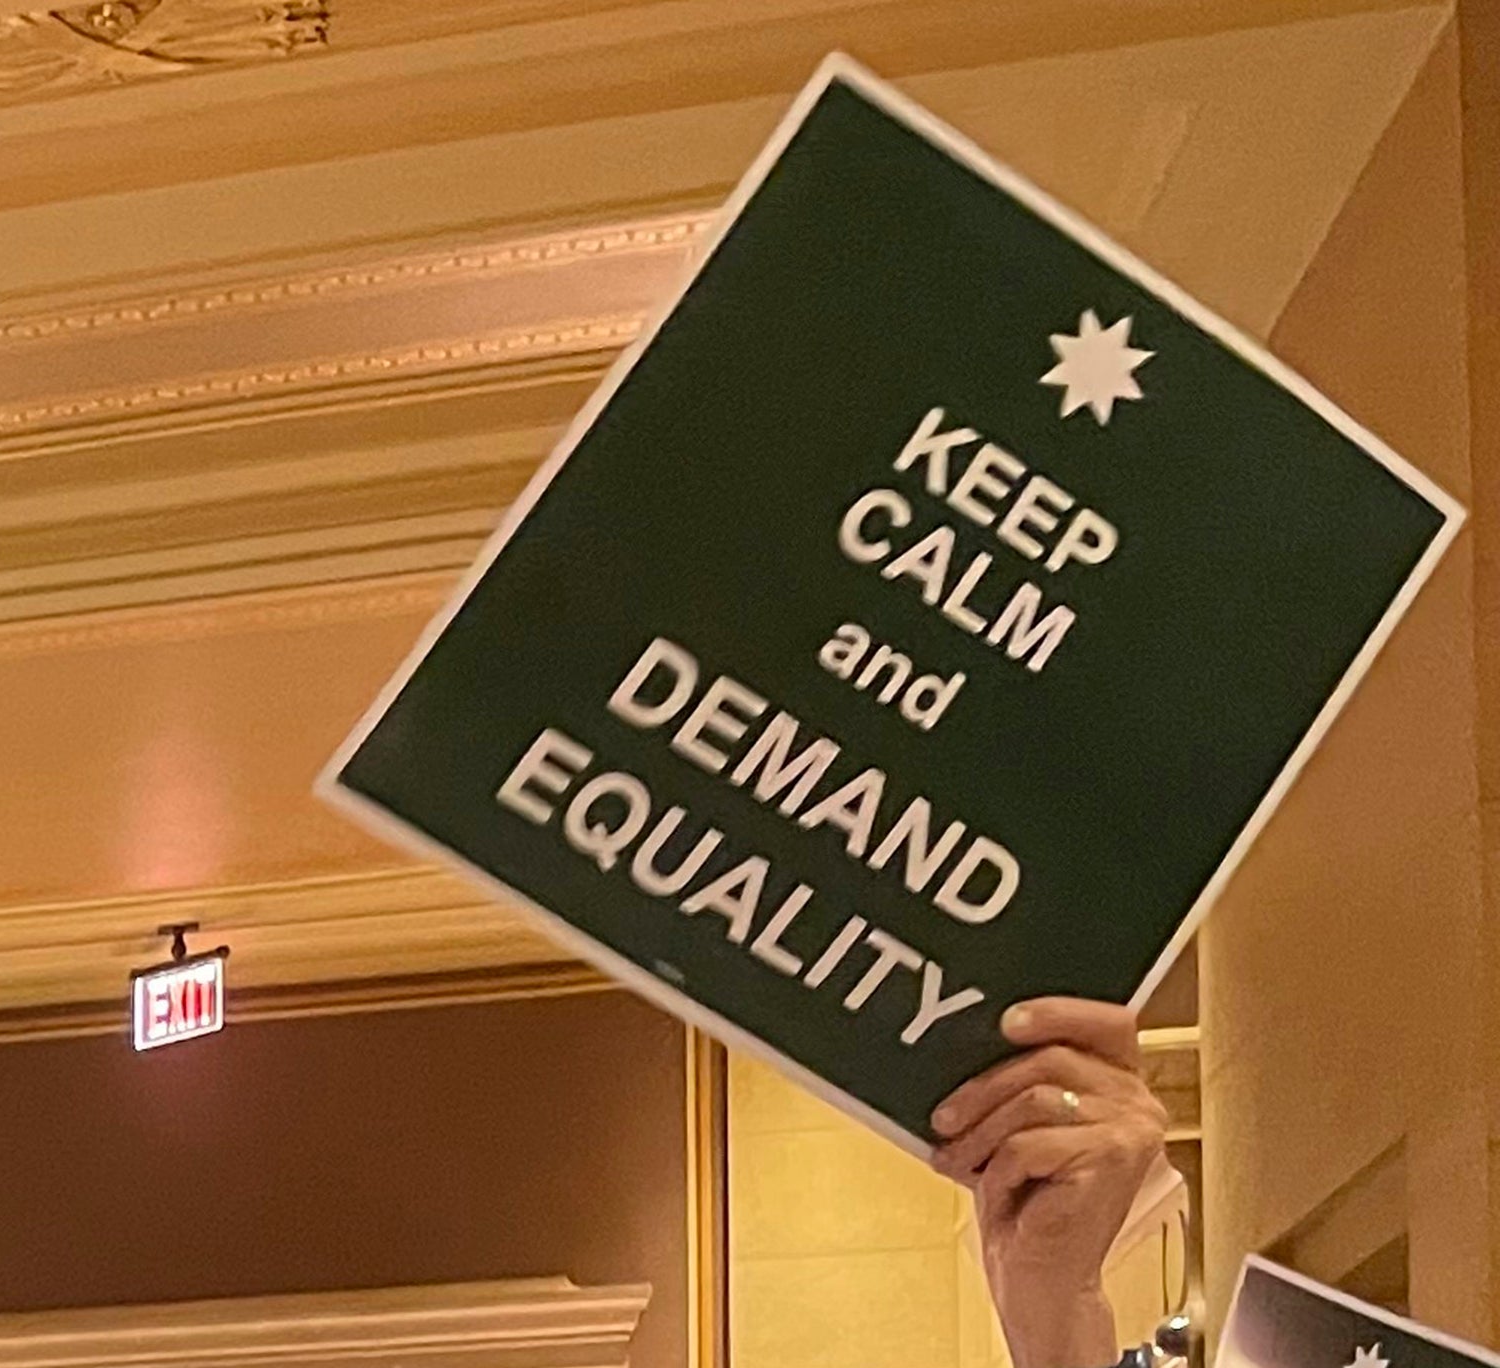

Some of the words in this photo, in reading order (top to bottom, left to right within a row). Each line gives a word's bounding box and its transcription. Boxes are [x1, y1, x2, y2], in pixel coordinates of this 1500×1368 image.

[893, 407, 1120, 573] KEEP
[837, 488, 1077, 674] CALM
[818, 621, 967, 731] and
[606, 635, 1022, 925] DEMAND
[496, 726, 985, 1047] EQUALITY
[148, 970, 216, 1039] EXIT
